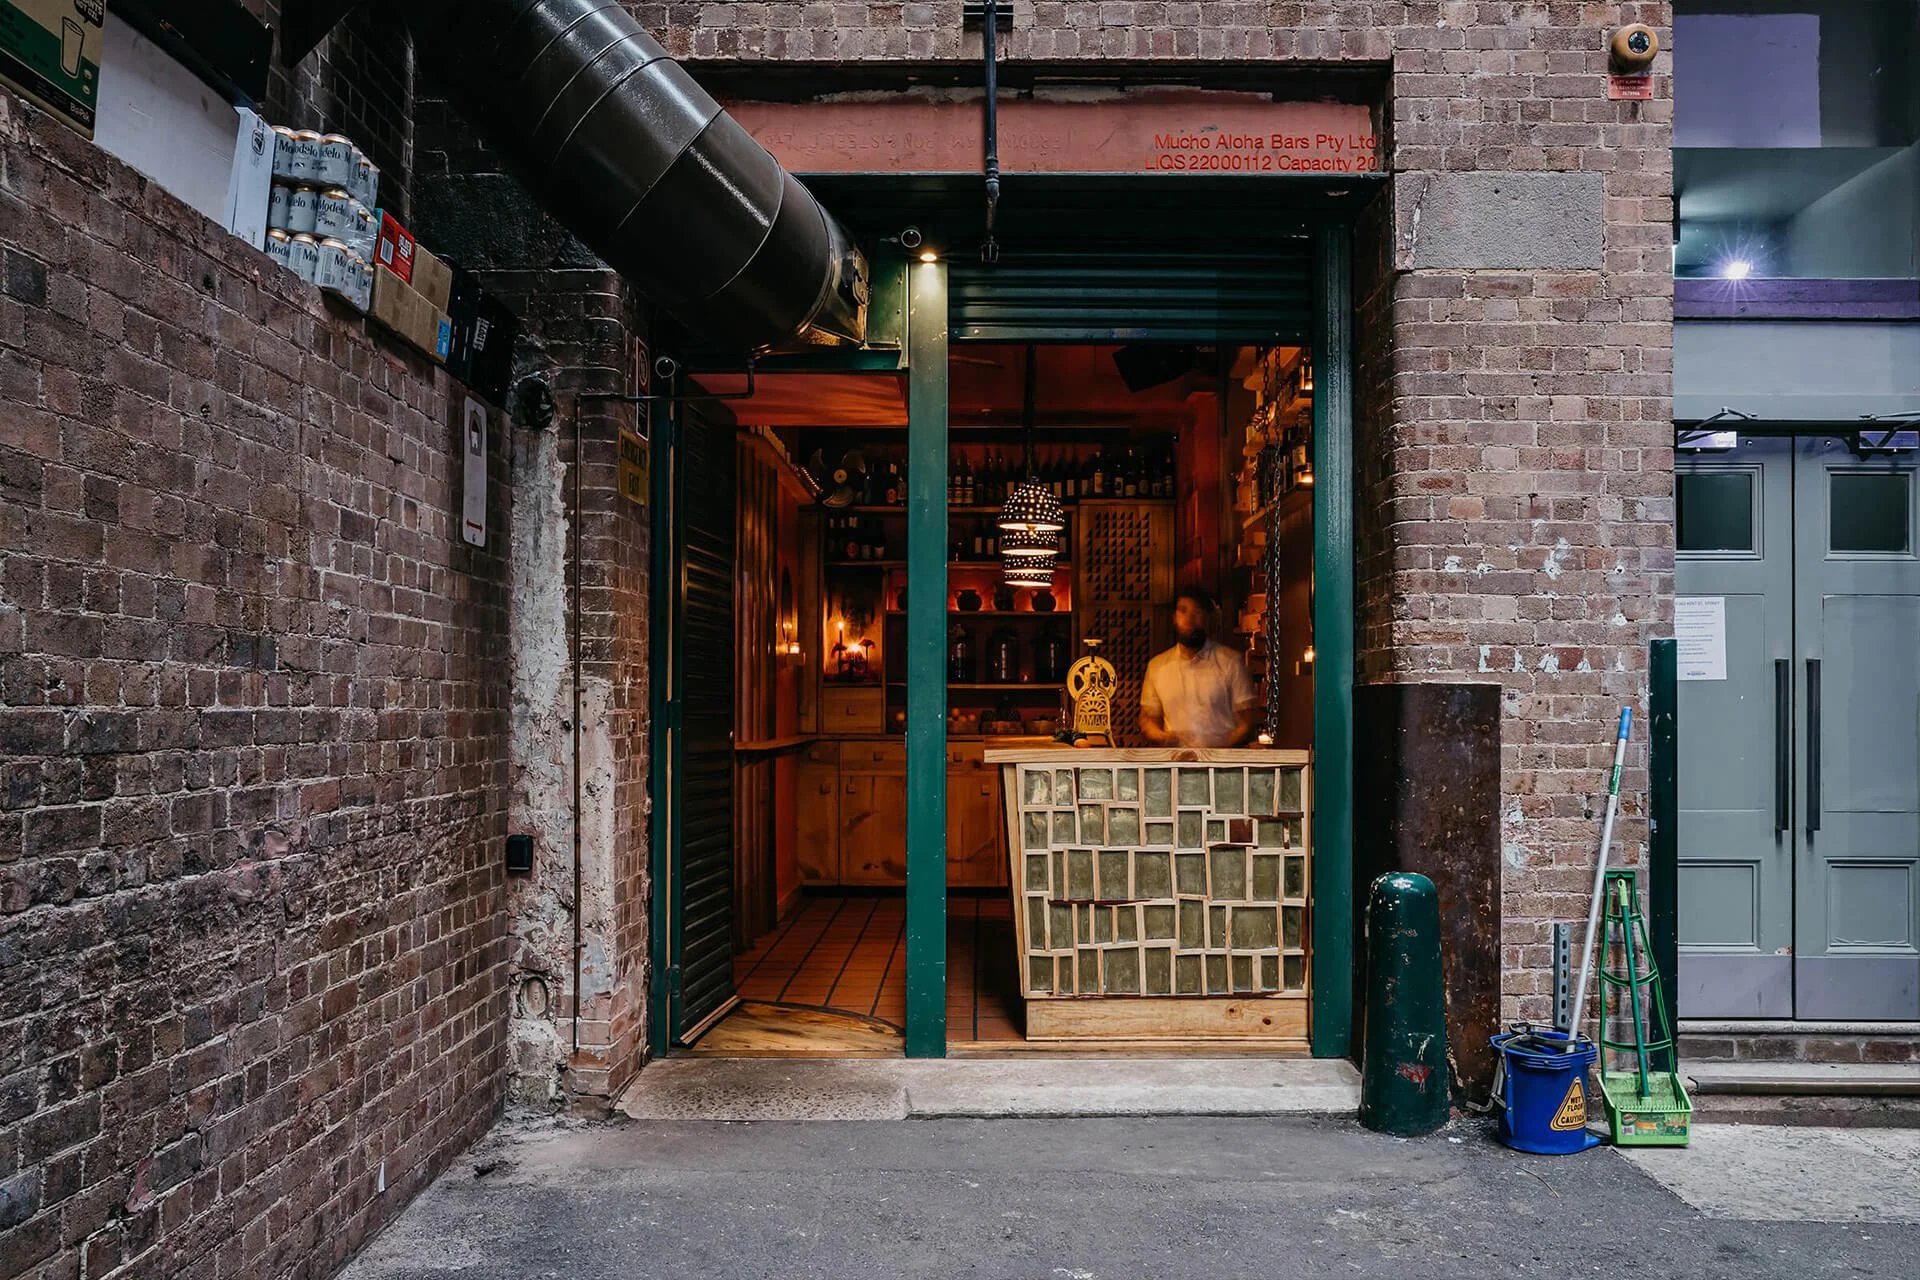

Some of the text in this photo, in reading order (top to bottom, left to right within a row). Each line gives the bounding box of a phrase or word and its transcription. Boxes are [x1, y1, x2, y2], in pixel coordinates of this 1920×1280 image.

[1154, 134, 1377, 152] Mucho Aloha Bars Pty Ltd
[1278, 155, 1351, 172] Capacity
[1357, 156, 1378, 171] 20
[1570, 1096, 1581, 1104] WET
